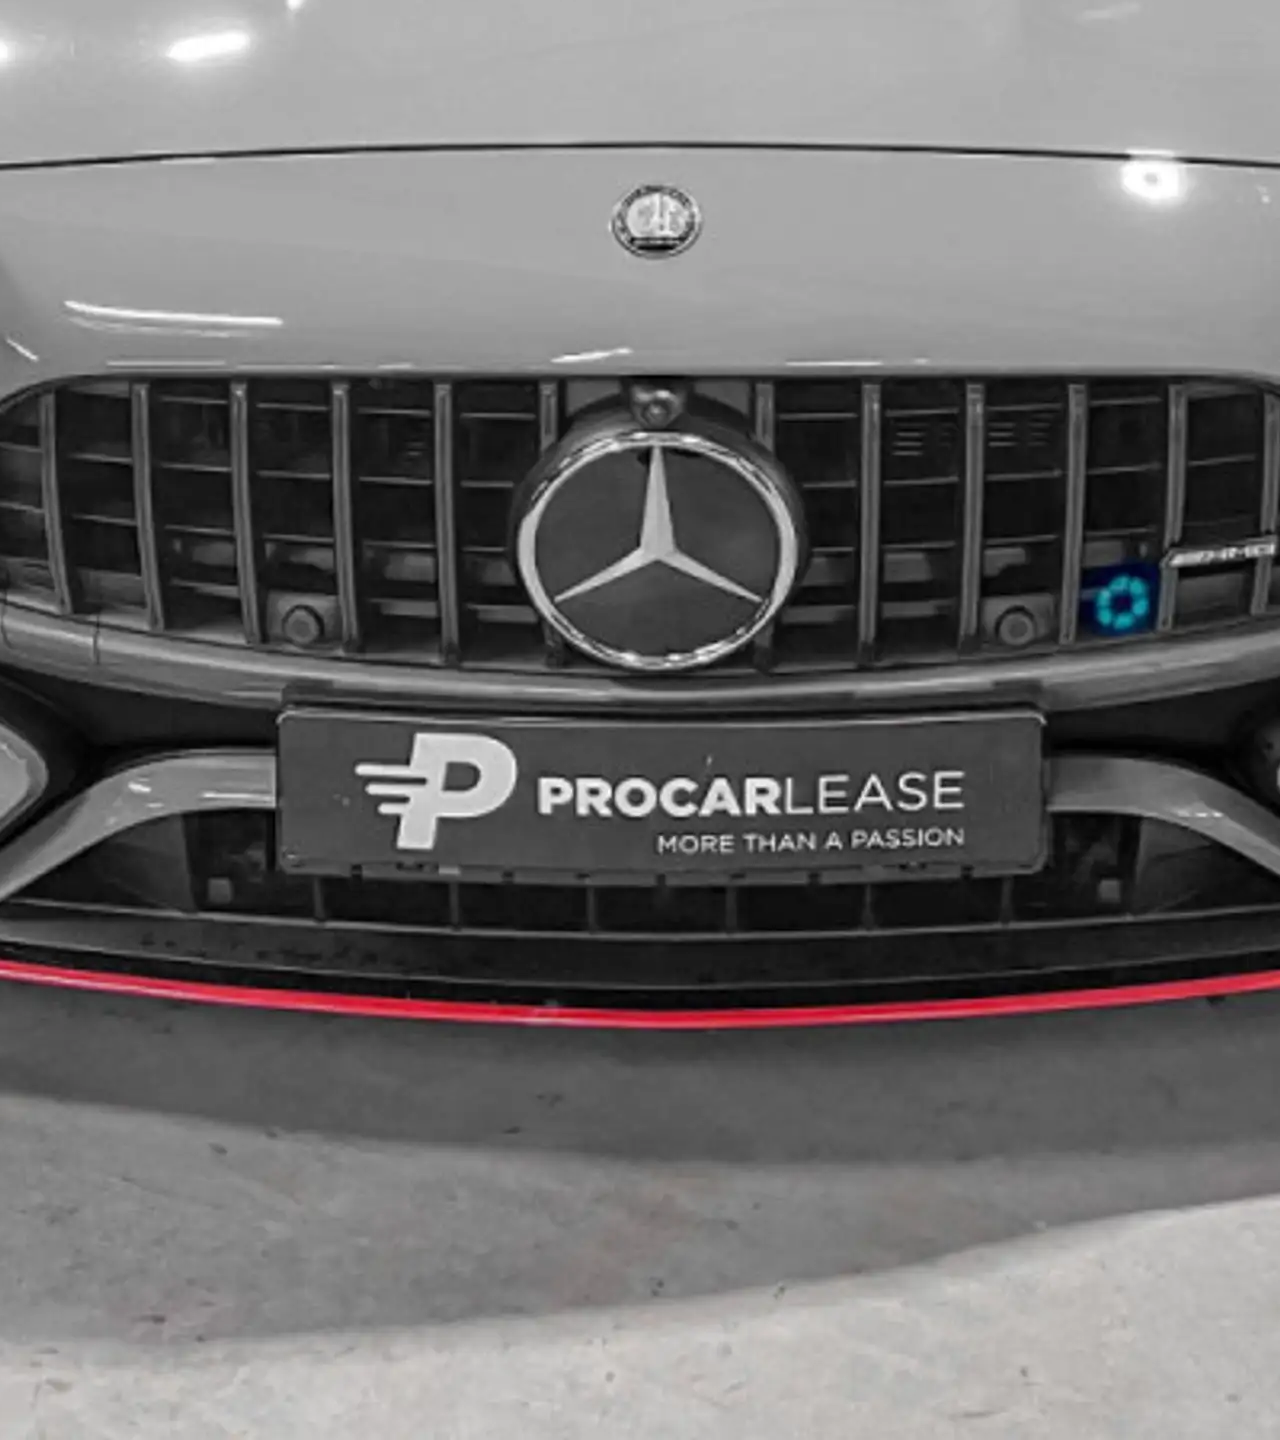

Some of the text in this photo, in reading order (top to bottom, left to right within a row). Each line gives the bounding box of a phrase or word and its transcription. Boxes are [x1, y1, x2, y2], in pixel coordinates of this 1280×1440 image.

[537, 771, 966, 818] PROCARLEASE
[657, 827, 966, 855] MORE THAN A PASSION
